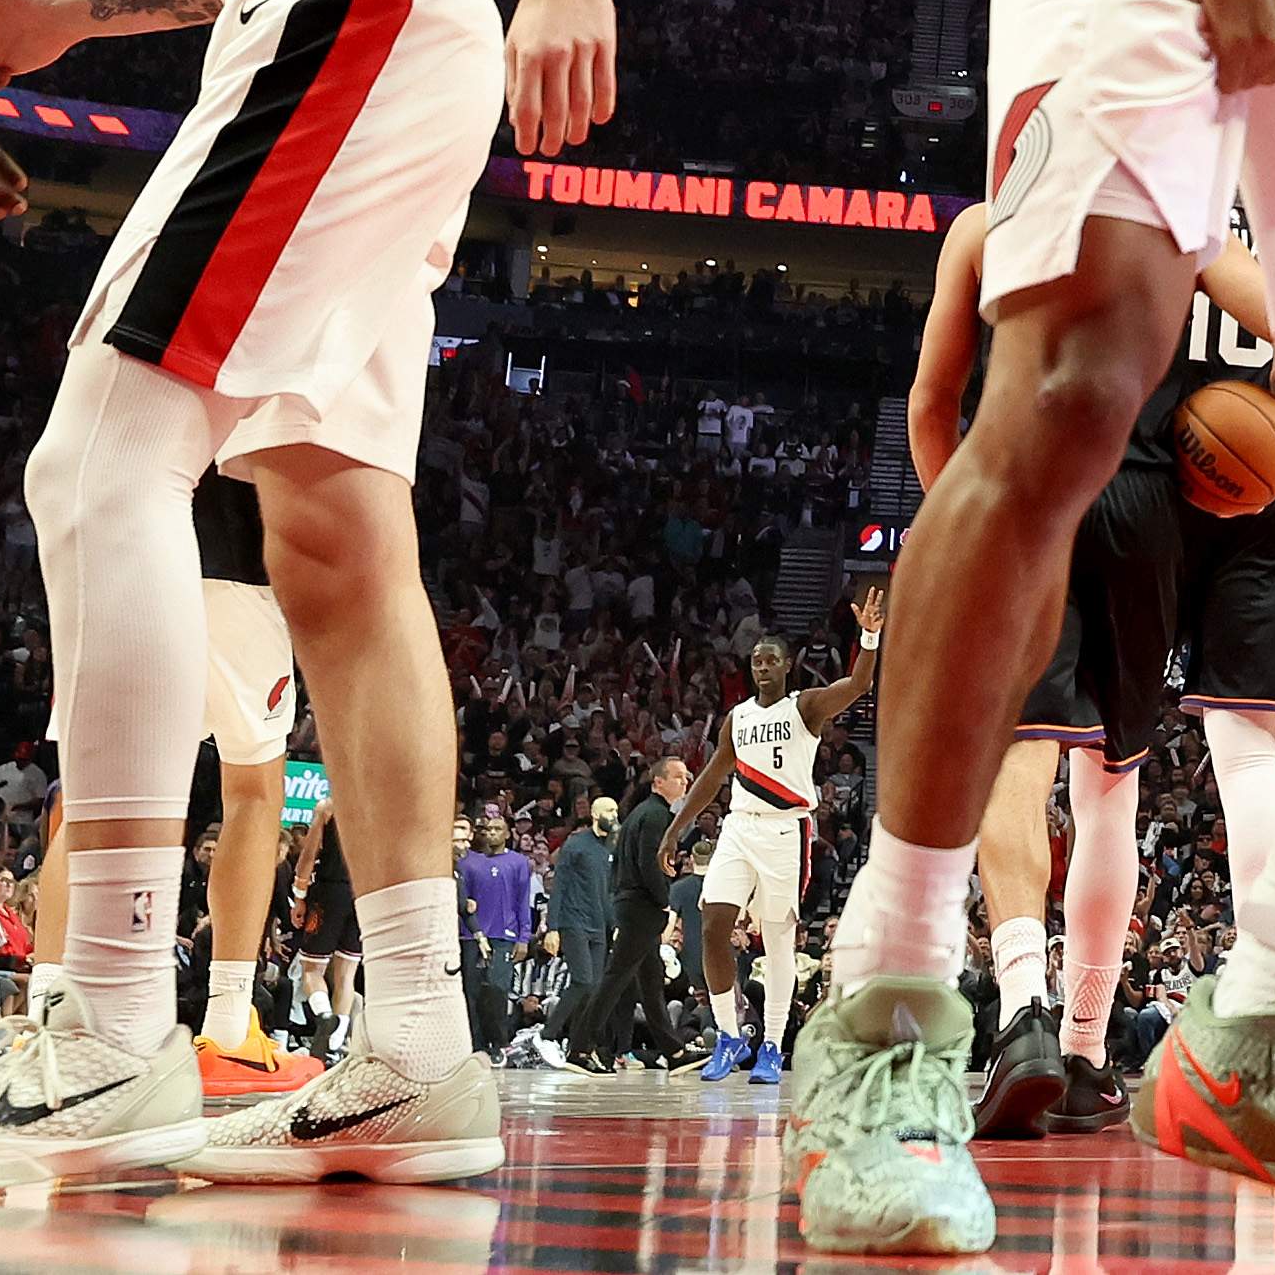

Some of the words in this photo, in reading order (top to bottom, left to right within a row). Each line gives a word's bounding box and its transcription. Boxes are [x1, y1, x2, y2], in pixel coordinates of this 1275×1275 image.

[523, 161, 733, 217] TOUMANI
[745, 181, 936, 231] CAMARA
[737, 720, 791, 749] BLAZERS
[773, 746, 783, 769] 5
